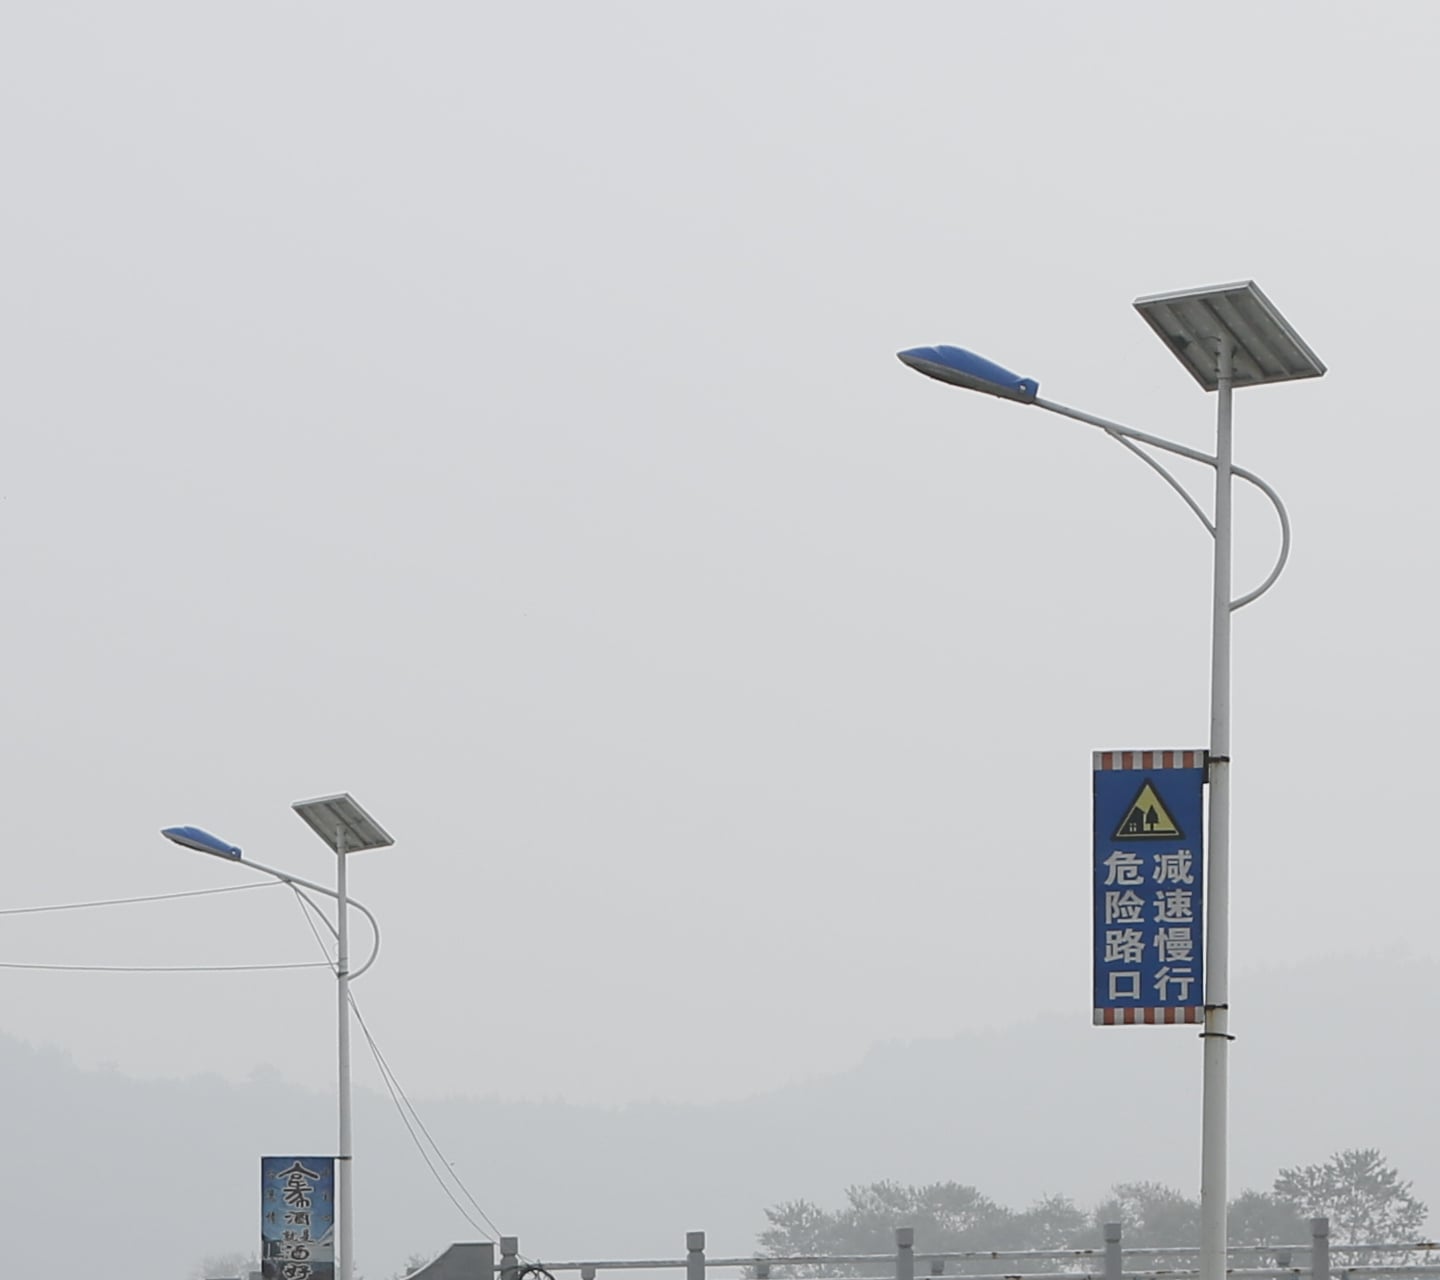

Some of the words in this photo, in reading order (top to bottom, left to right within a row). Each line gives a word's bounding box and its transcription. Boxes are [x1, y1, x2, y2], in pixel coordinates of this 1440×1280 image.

[1104, 849, 1144, 1000] 危险路口
[1152, 849, 1194, 1001] 减速慢行
